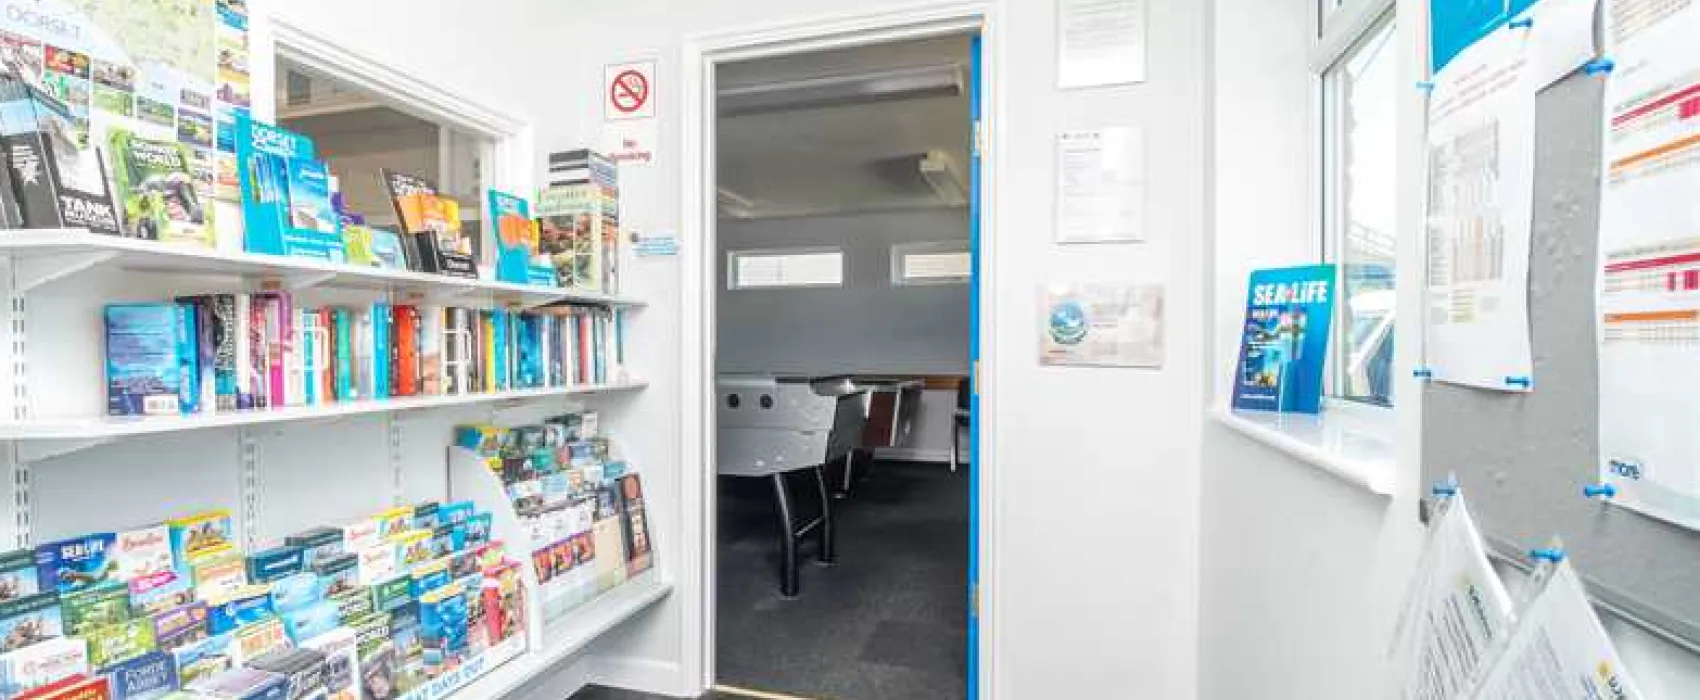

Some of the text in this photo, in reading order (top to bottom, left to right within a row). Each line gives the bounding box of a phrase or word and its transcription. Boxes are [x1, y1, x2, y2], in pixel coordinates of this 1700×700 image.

[60, 195, 114, 217] TANK
[1253, 283, 1286, 305] SEA
[431, 671, 461, 696] DAYS
[463, 656, 485, 679] OUT
